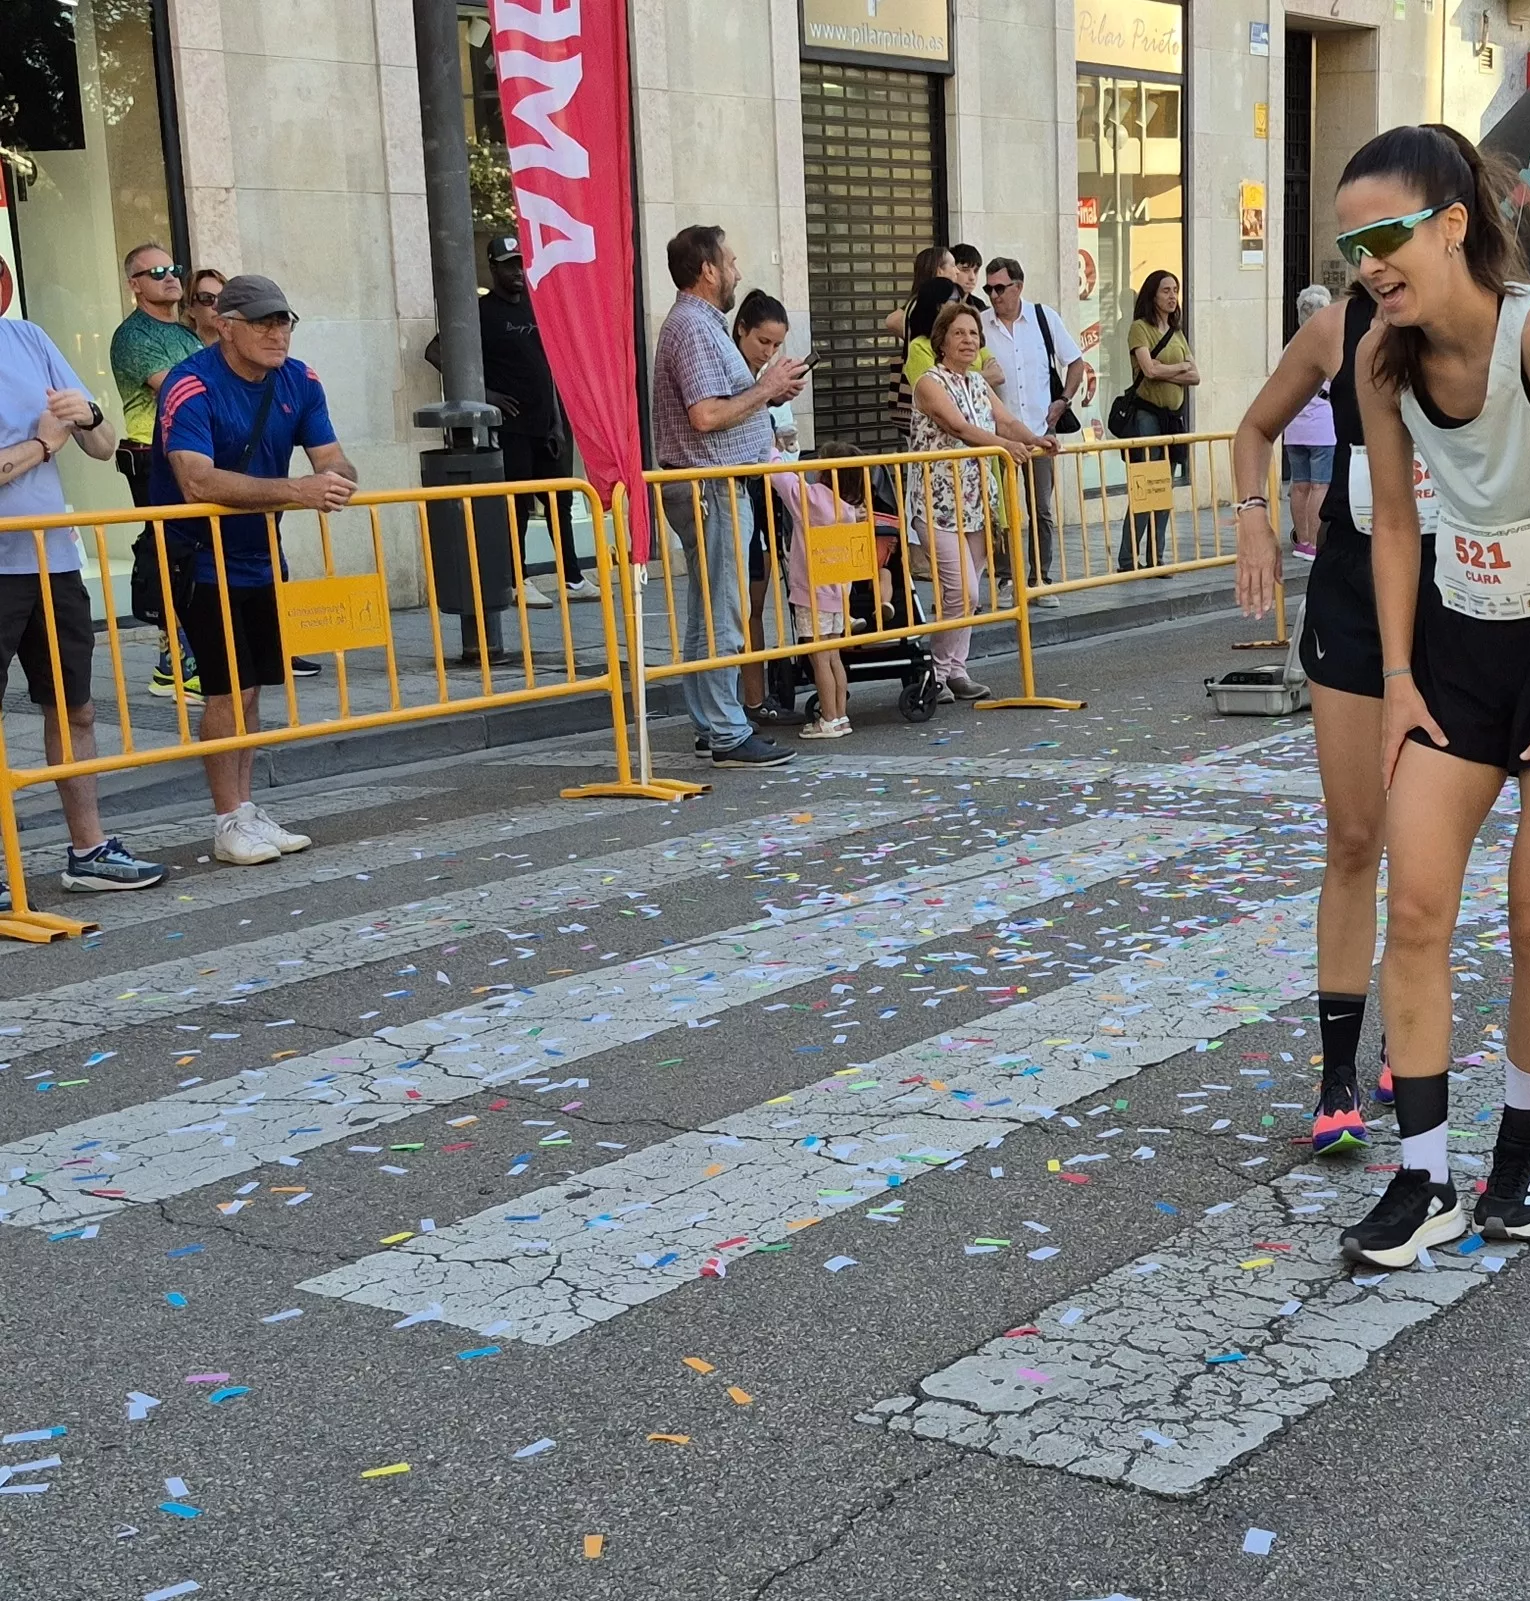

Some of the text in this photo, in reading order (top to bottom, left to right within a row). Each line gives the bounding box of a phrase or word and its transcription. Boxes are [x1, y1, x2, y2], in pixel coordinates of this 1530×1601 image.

[809, 21, 944, 51] www.pilarprieto.es
[1079, 10, 1180, 56] Pilar Prieto
[1454, 535, 1512, 569] 521
[1465, 570, 1502, 585] CLARA
